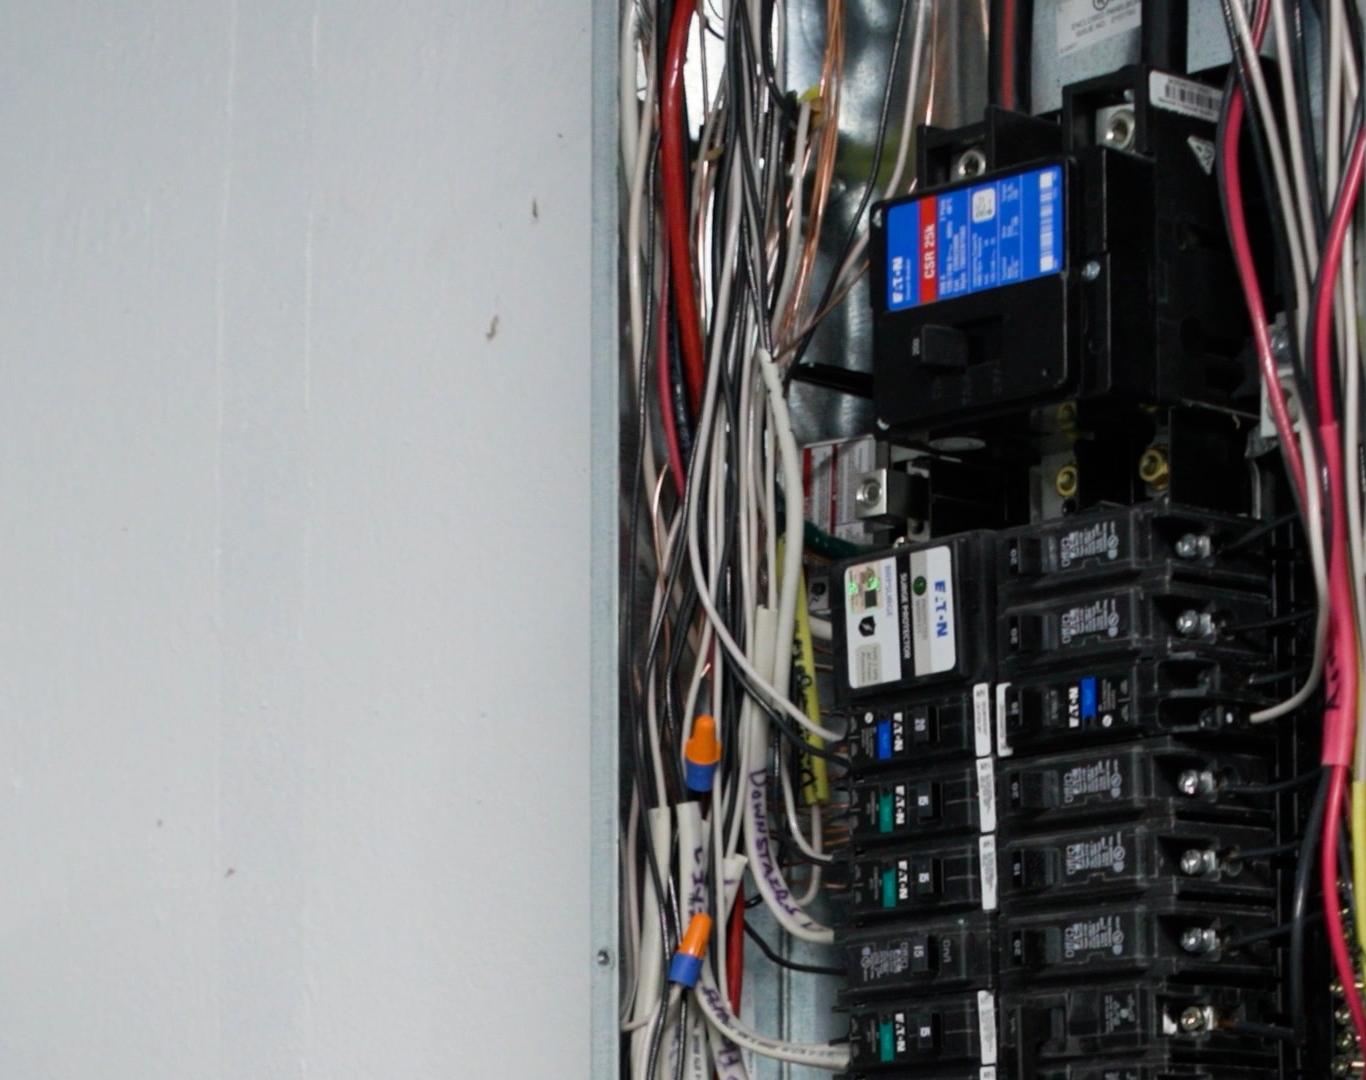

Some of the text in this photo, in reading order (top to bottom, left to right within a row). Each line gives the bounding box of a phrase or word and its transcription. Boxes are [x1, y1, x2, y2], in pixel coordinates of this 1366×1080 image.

[923, 250, 936, 279] CSR
[900, 572, 912, 660] SURGE PROTECTOR
